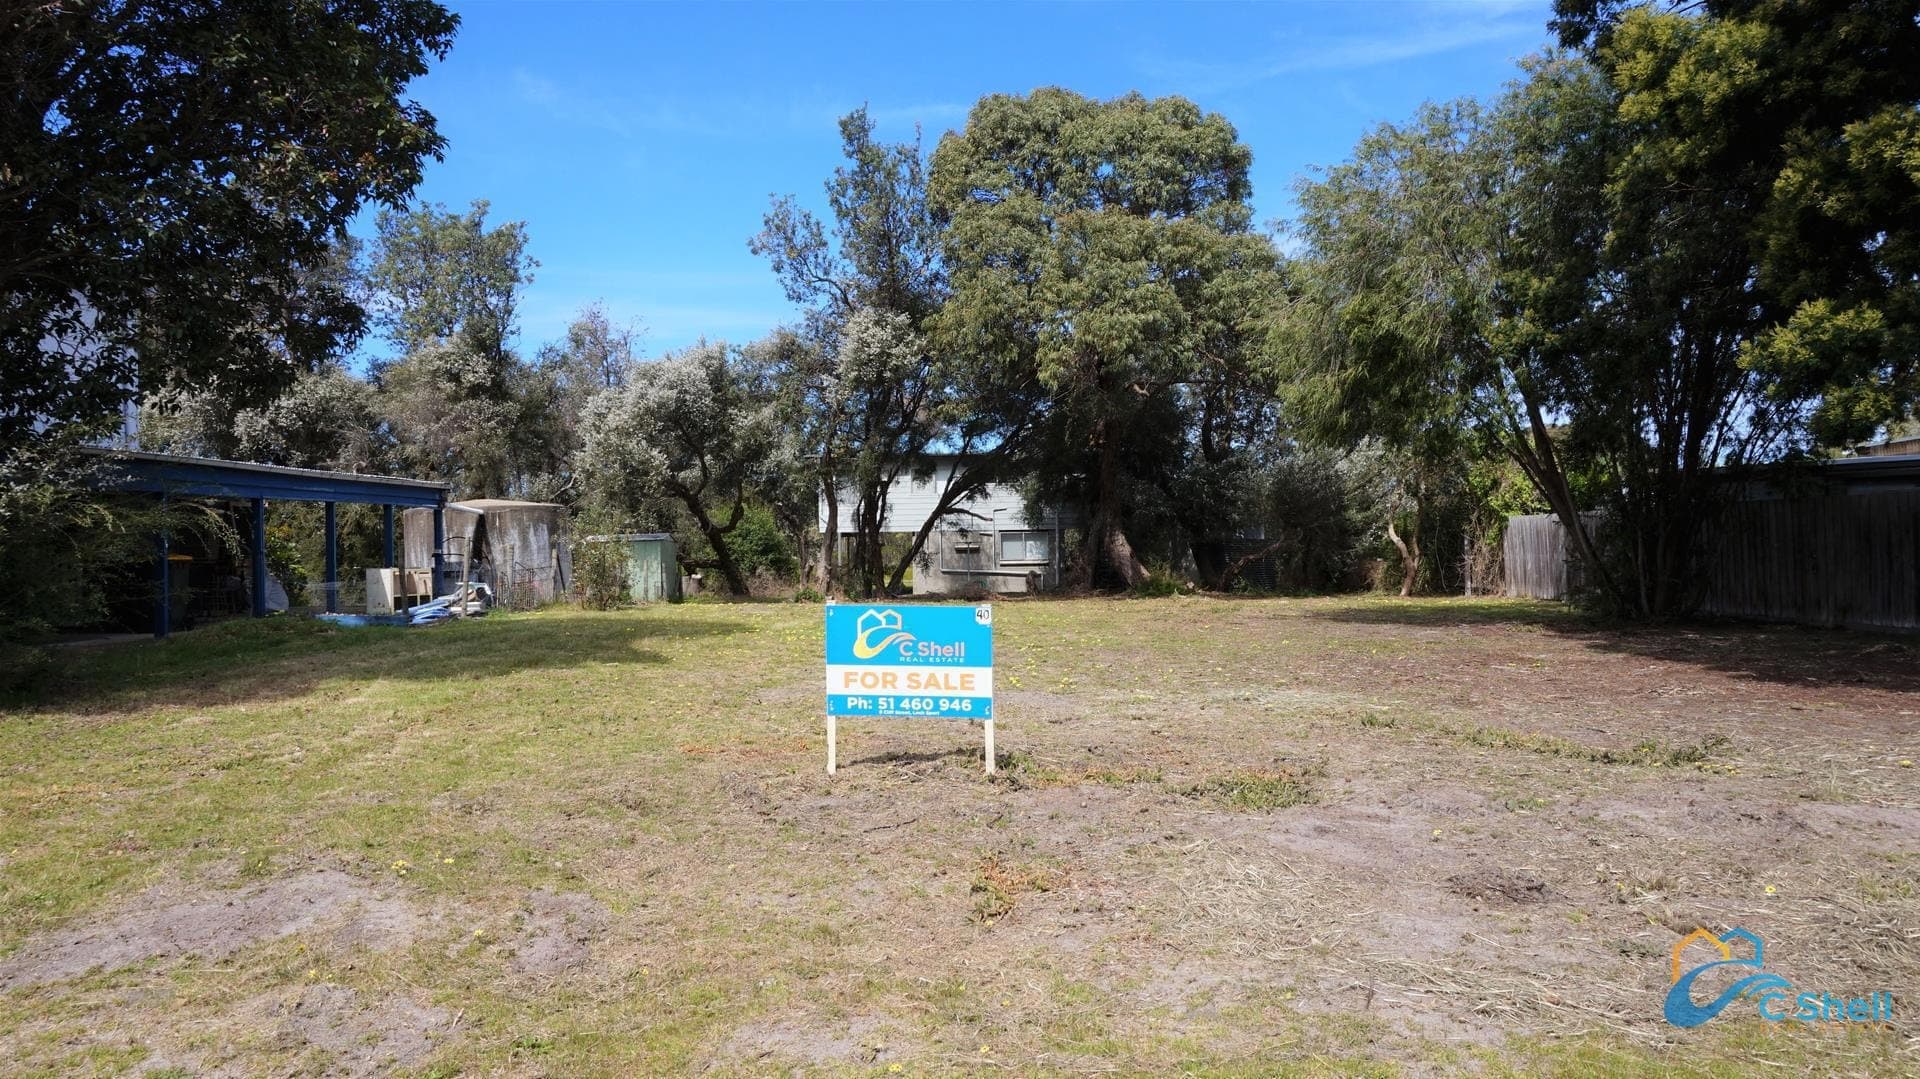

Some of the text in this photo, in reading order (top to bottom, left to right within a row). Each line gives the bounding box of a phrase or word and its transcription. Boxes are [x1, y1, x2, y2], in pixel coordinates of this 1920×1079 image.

[976, 609, 990, 620] 40
[899, 641, 965, 657] C Shell
[844, 671, 976, 691] FOR SALE
[847, 697, 972, 711] Ph: 51 460 946
